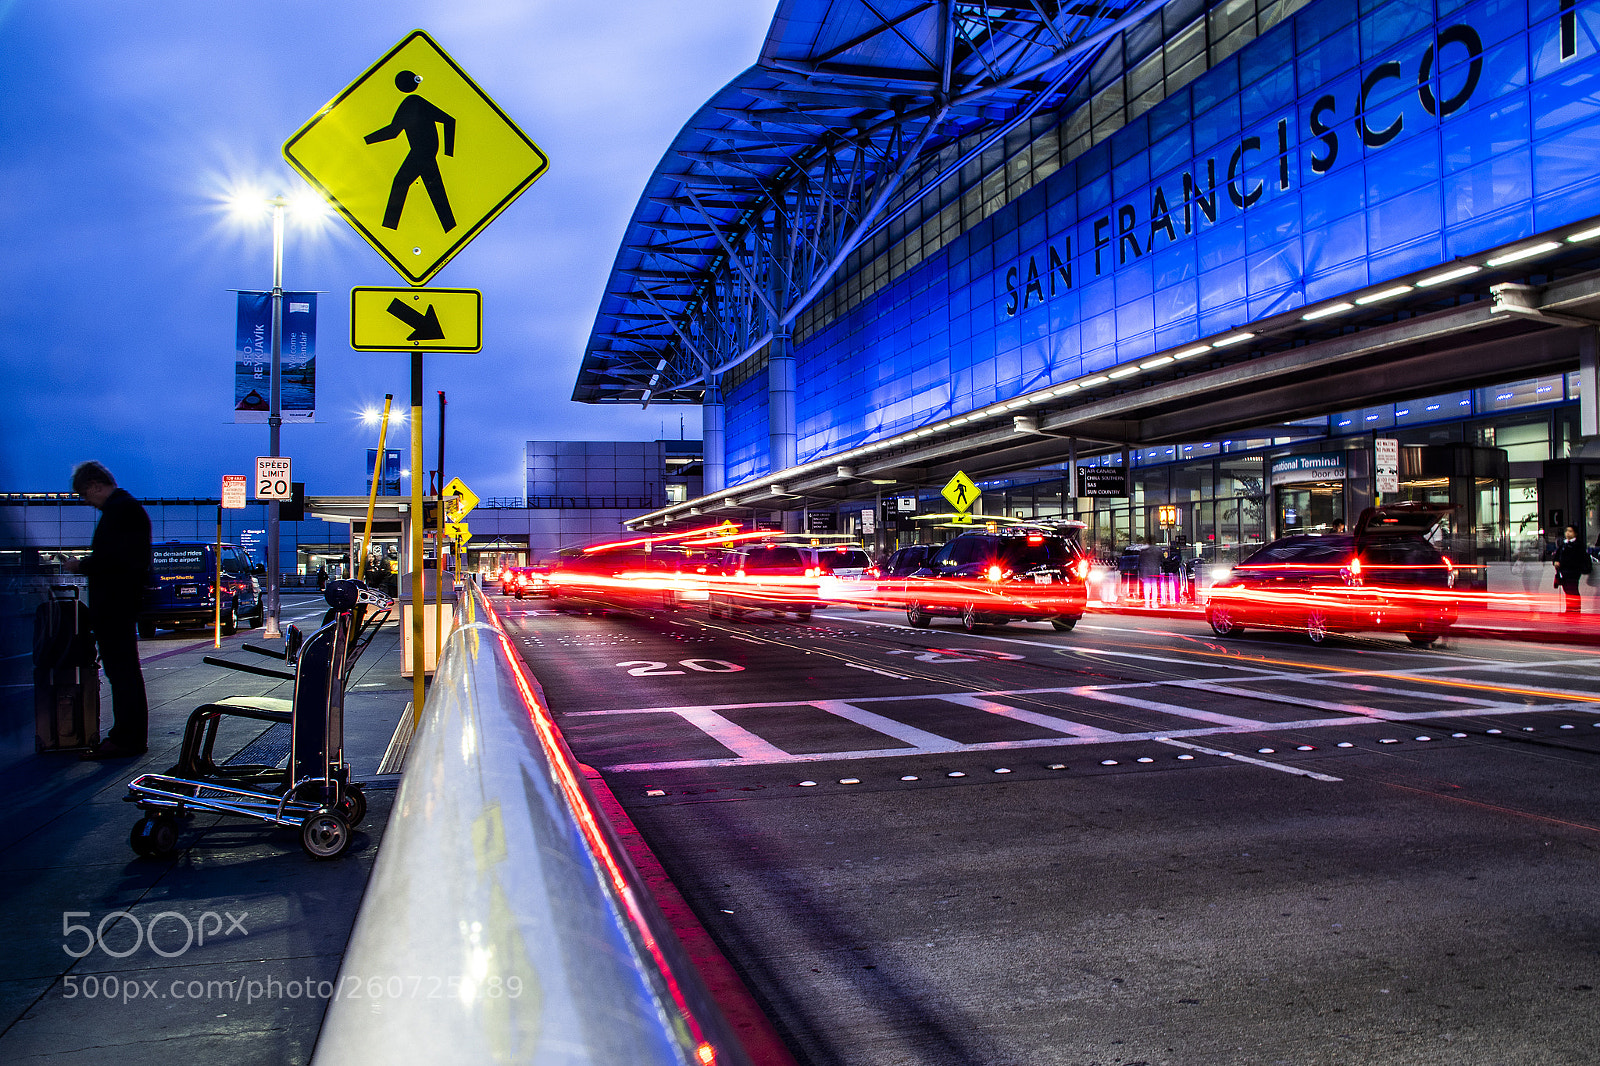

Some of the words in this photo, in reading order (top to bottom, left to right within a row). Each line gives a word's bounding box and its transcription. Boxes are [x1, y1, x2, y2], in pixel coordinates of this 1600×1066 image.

[1005, 236, 1073, 317] SAN
[1094, 24, 1483, 277] FRANCISCO
[243, 346, 252, 366] SFO
[253, 324, 265, 380] REYKJAVÍK
[288, 332, 297, 369] Welcome
[299, 331, 308, 370] Icelandair
[1079, 467, 1085, 476] 3
[1300, 456, 1340, 469] Terminal
[1334, 469, 1345, 477] 03
[259, 480, 288, 495] 20
[179, 556, 201, 564] airport.
[615, 658, 746, 678] 20
